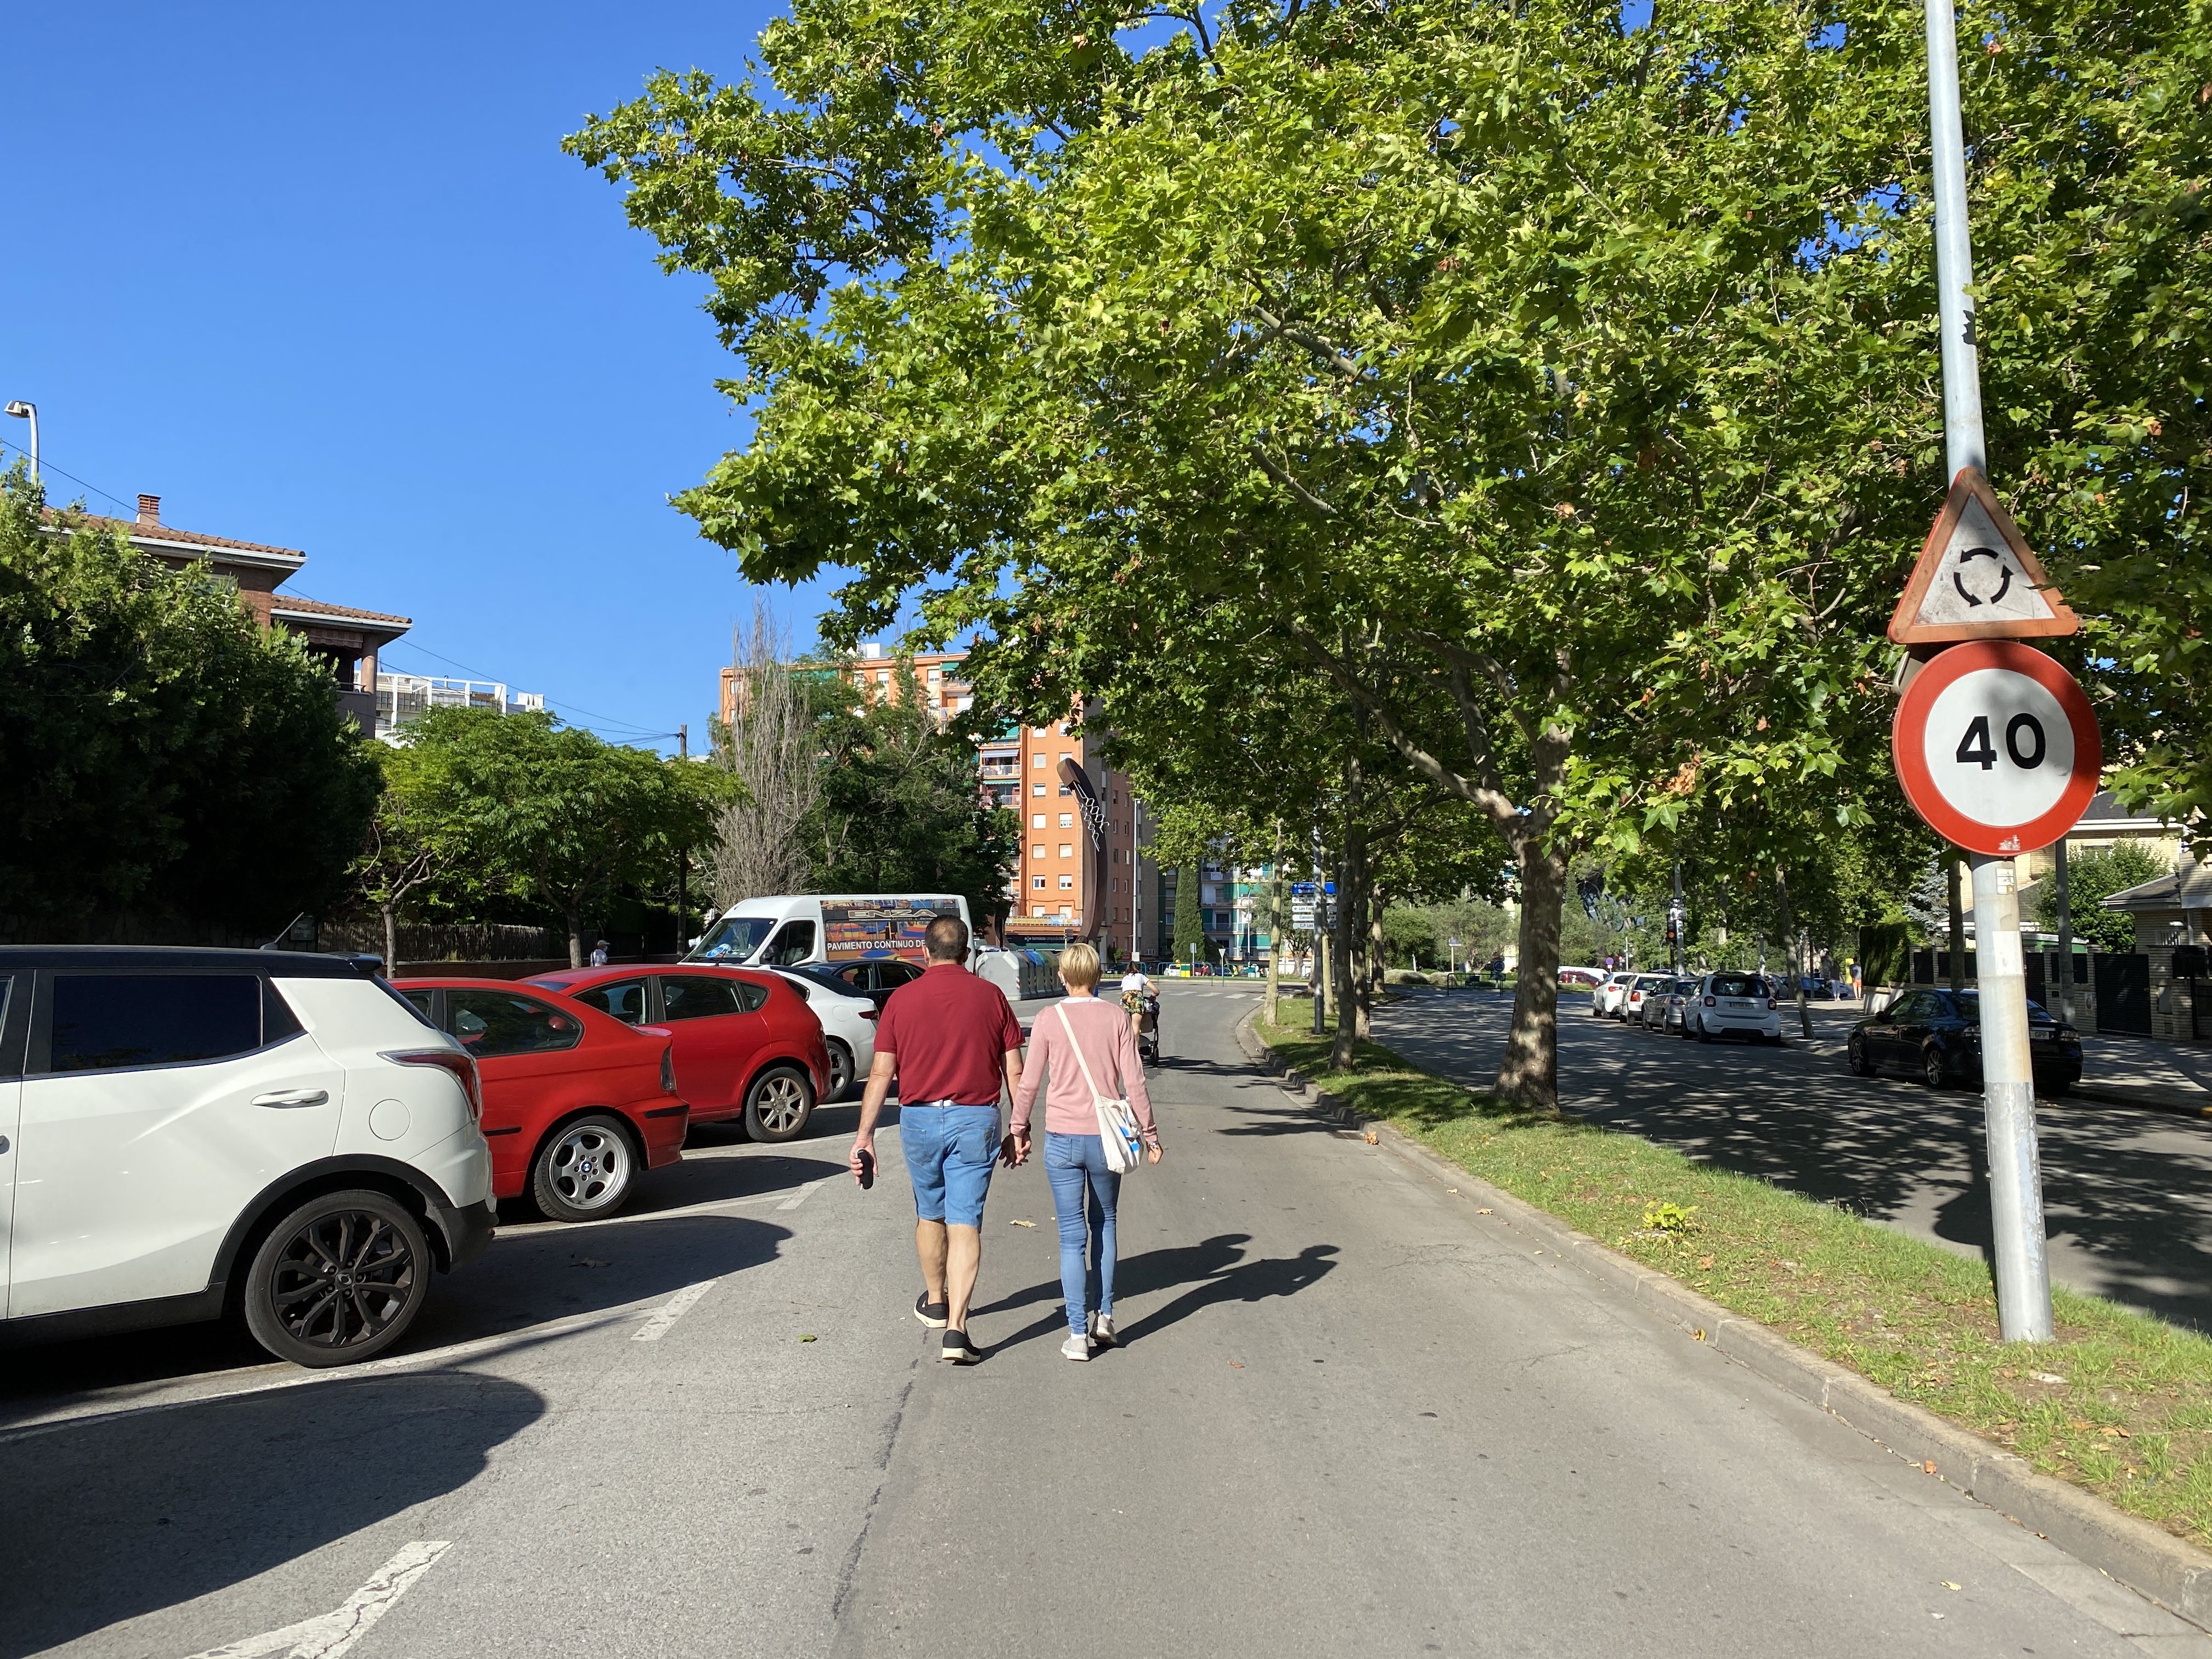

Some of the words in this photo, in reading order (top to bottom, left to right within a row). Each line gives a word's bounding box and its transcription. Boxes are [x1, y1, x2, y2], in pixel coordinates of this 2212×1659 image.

[1956, 713, 2046, 770] 40
[848, 909, 938, 918] ENZA
[827, 941, 872, 951] PAVIMENTO
[874, 940, 914, 949] CONTINUO
